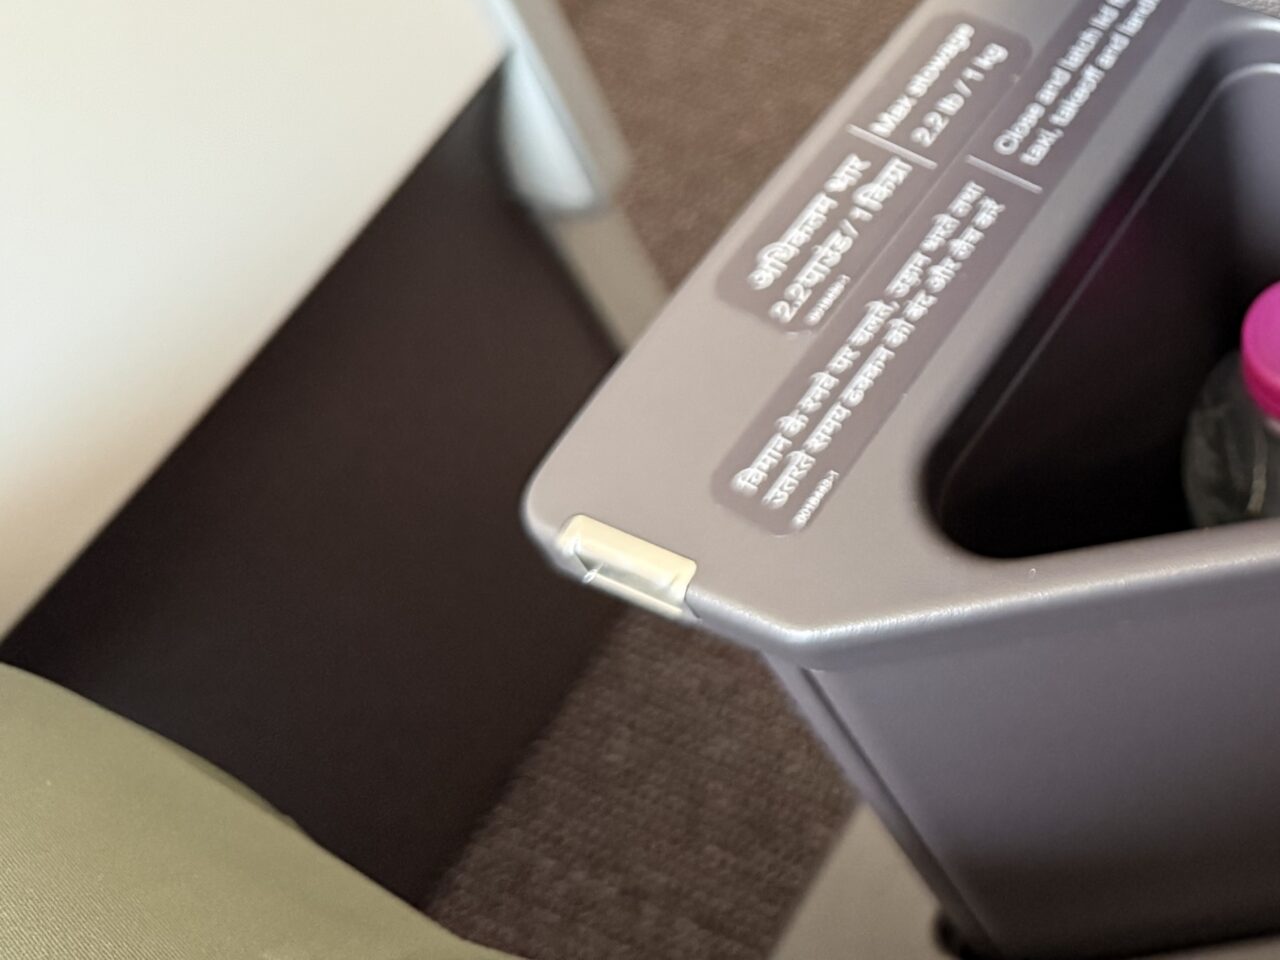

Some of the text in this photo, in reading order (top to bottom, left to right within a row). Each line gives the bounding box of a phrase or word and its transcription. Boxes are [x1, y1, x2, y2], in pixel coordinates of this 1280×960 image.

[961, 67, 985, 82] 1
[971, 42, 1008, 71] kg
[868, 23, 975, 138] Max stowage
[993, 102, 1046, 156] Close
[1035, 66, 1072, 106] and
[1057, 26, 1104, 72] latch
[1089, 3, 1120, 30] lid
[1049, 63, 1105, 127] takeoff
[1095, 30, 1131, 70] and
[934, 92, 965, 116] lb
[910, 111, 949, 148] 2.2
[824, 153, 871, 192] भार
